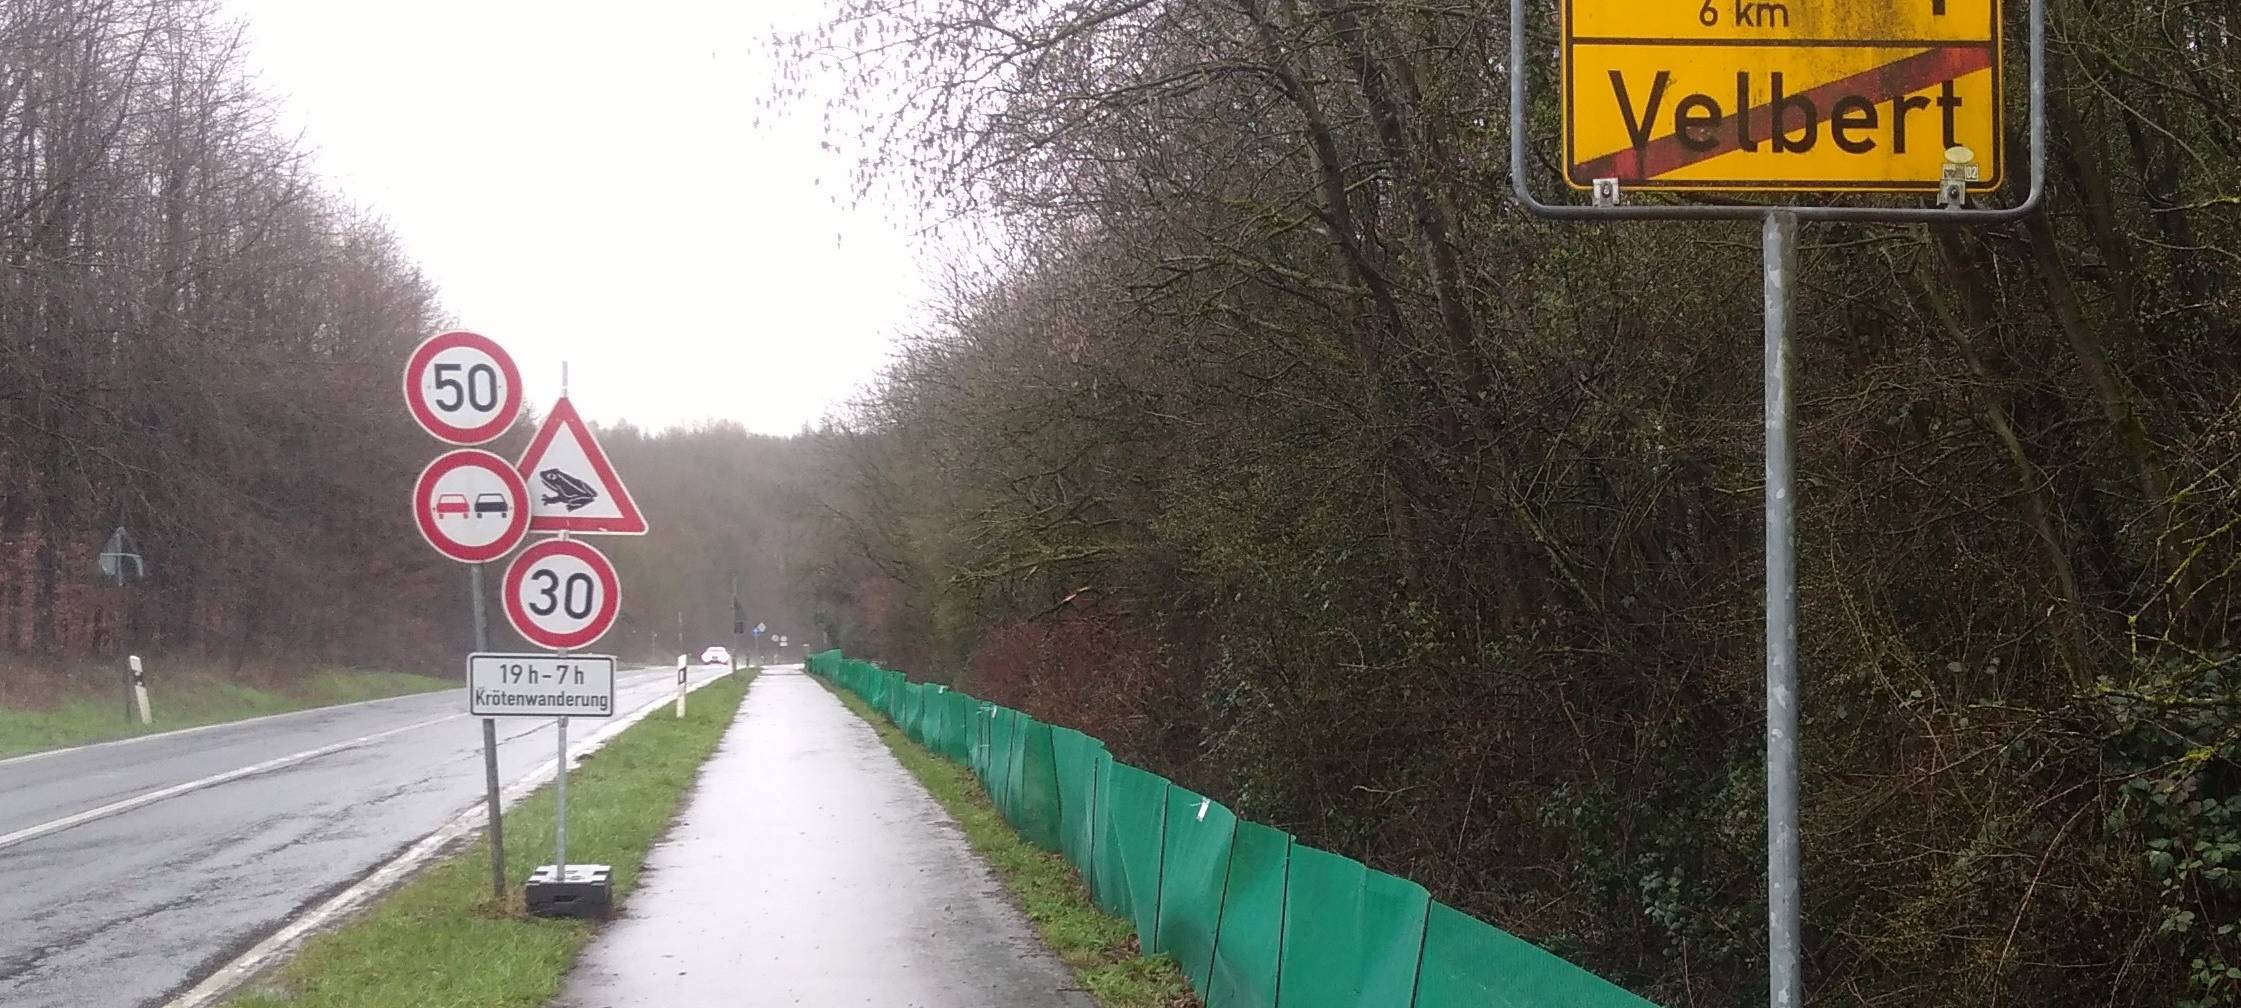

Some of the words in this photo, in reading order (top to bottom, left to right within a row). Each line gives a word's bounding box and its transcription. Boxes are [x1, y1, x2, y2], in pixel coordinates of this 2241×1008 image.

[1699, 0, 1718, 26] 6
[1735, 0, 1789, 27] km
[1608, 69, 1963, 154] Velbert
[433, 363, 498, 412] 50
[529, 569, 593, 619] 30
[475, 689, 608, 711] Krötenwanderung
